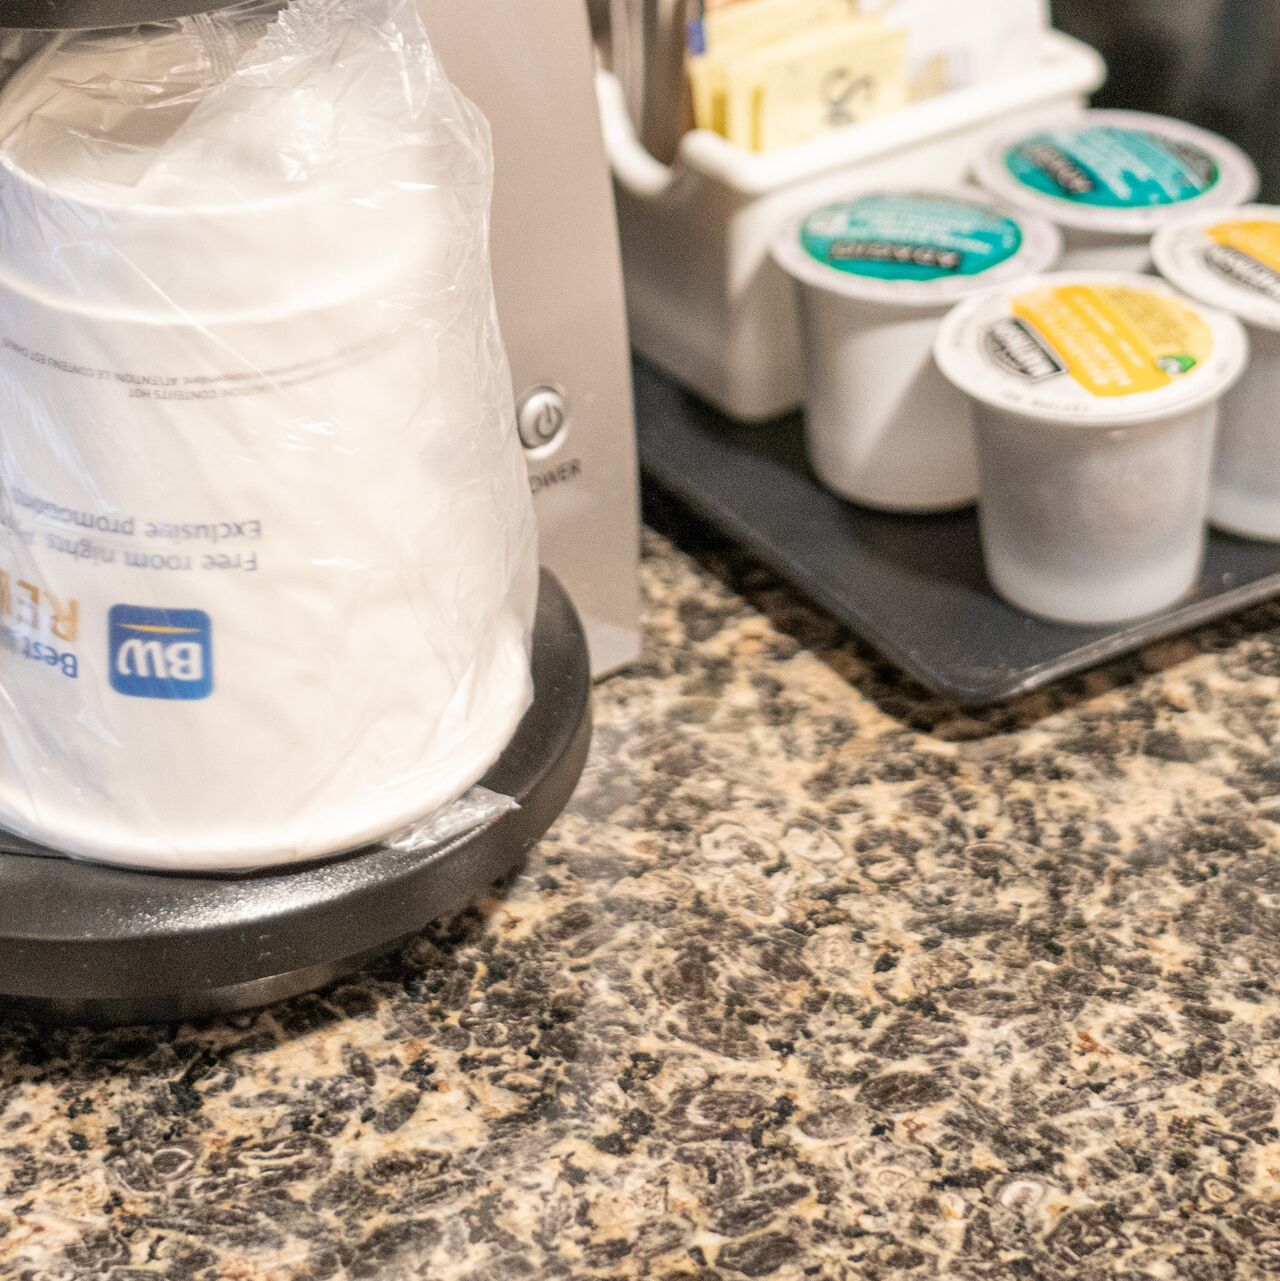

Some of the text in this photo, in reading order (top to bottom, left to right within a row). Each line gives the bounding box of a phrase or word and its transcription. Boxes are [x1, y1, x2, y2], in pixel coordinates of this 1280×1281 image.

[527, 459, 582, 495] OWER
[122, 552, 192, 570] room
[202, 551, 258, 572] Free
[117, 638, 203, 682] BW
